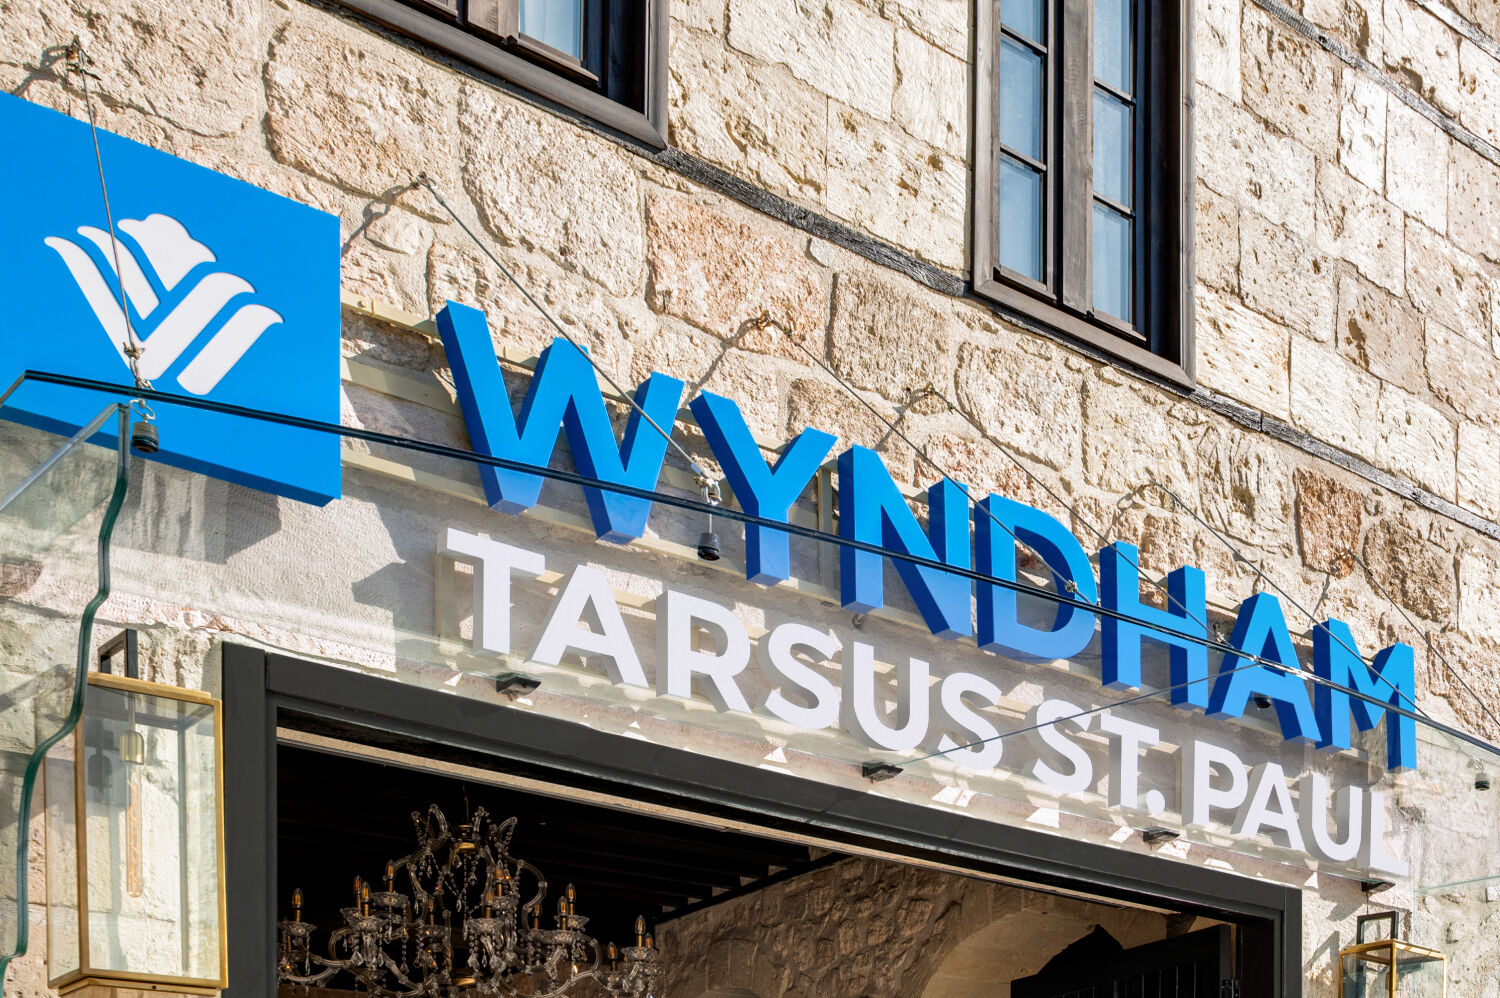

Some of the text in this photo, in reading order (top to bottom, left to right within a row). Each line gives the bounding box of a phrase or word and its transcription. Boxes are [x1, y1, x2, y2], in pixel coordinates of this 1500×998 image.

[435, 301, 1417, 772] WYNDHAM
[436, 528, 1408, 877] TARSUS ST. PAUL
